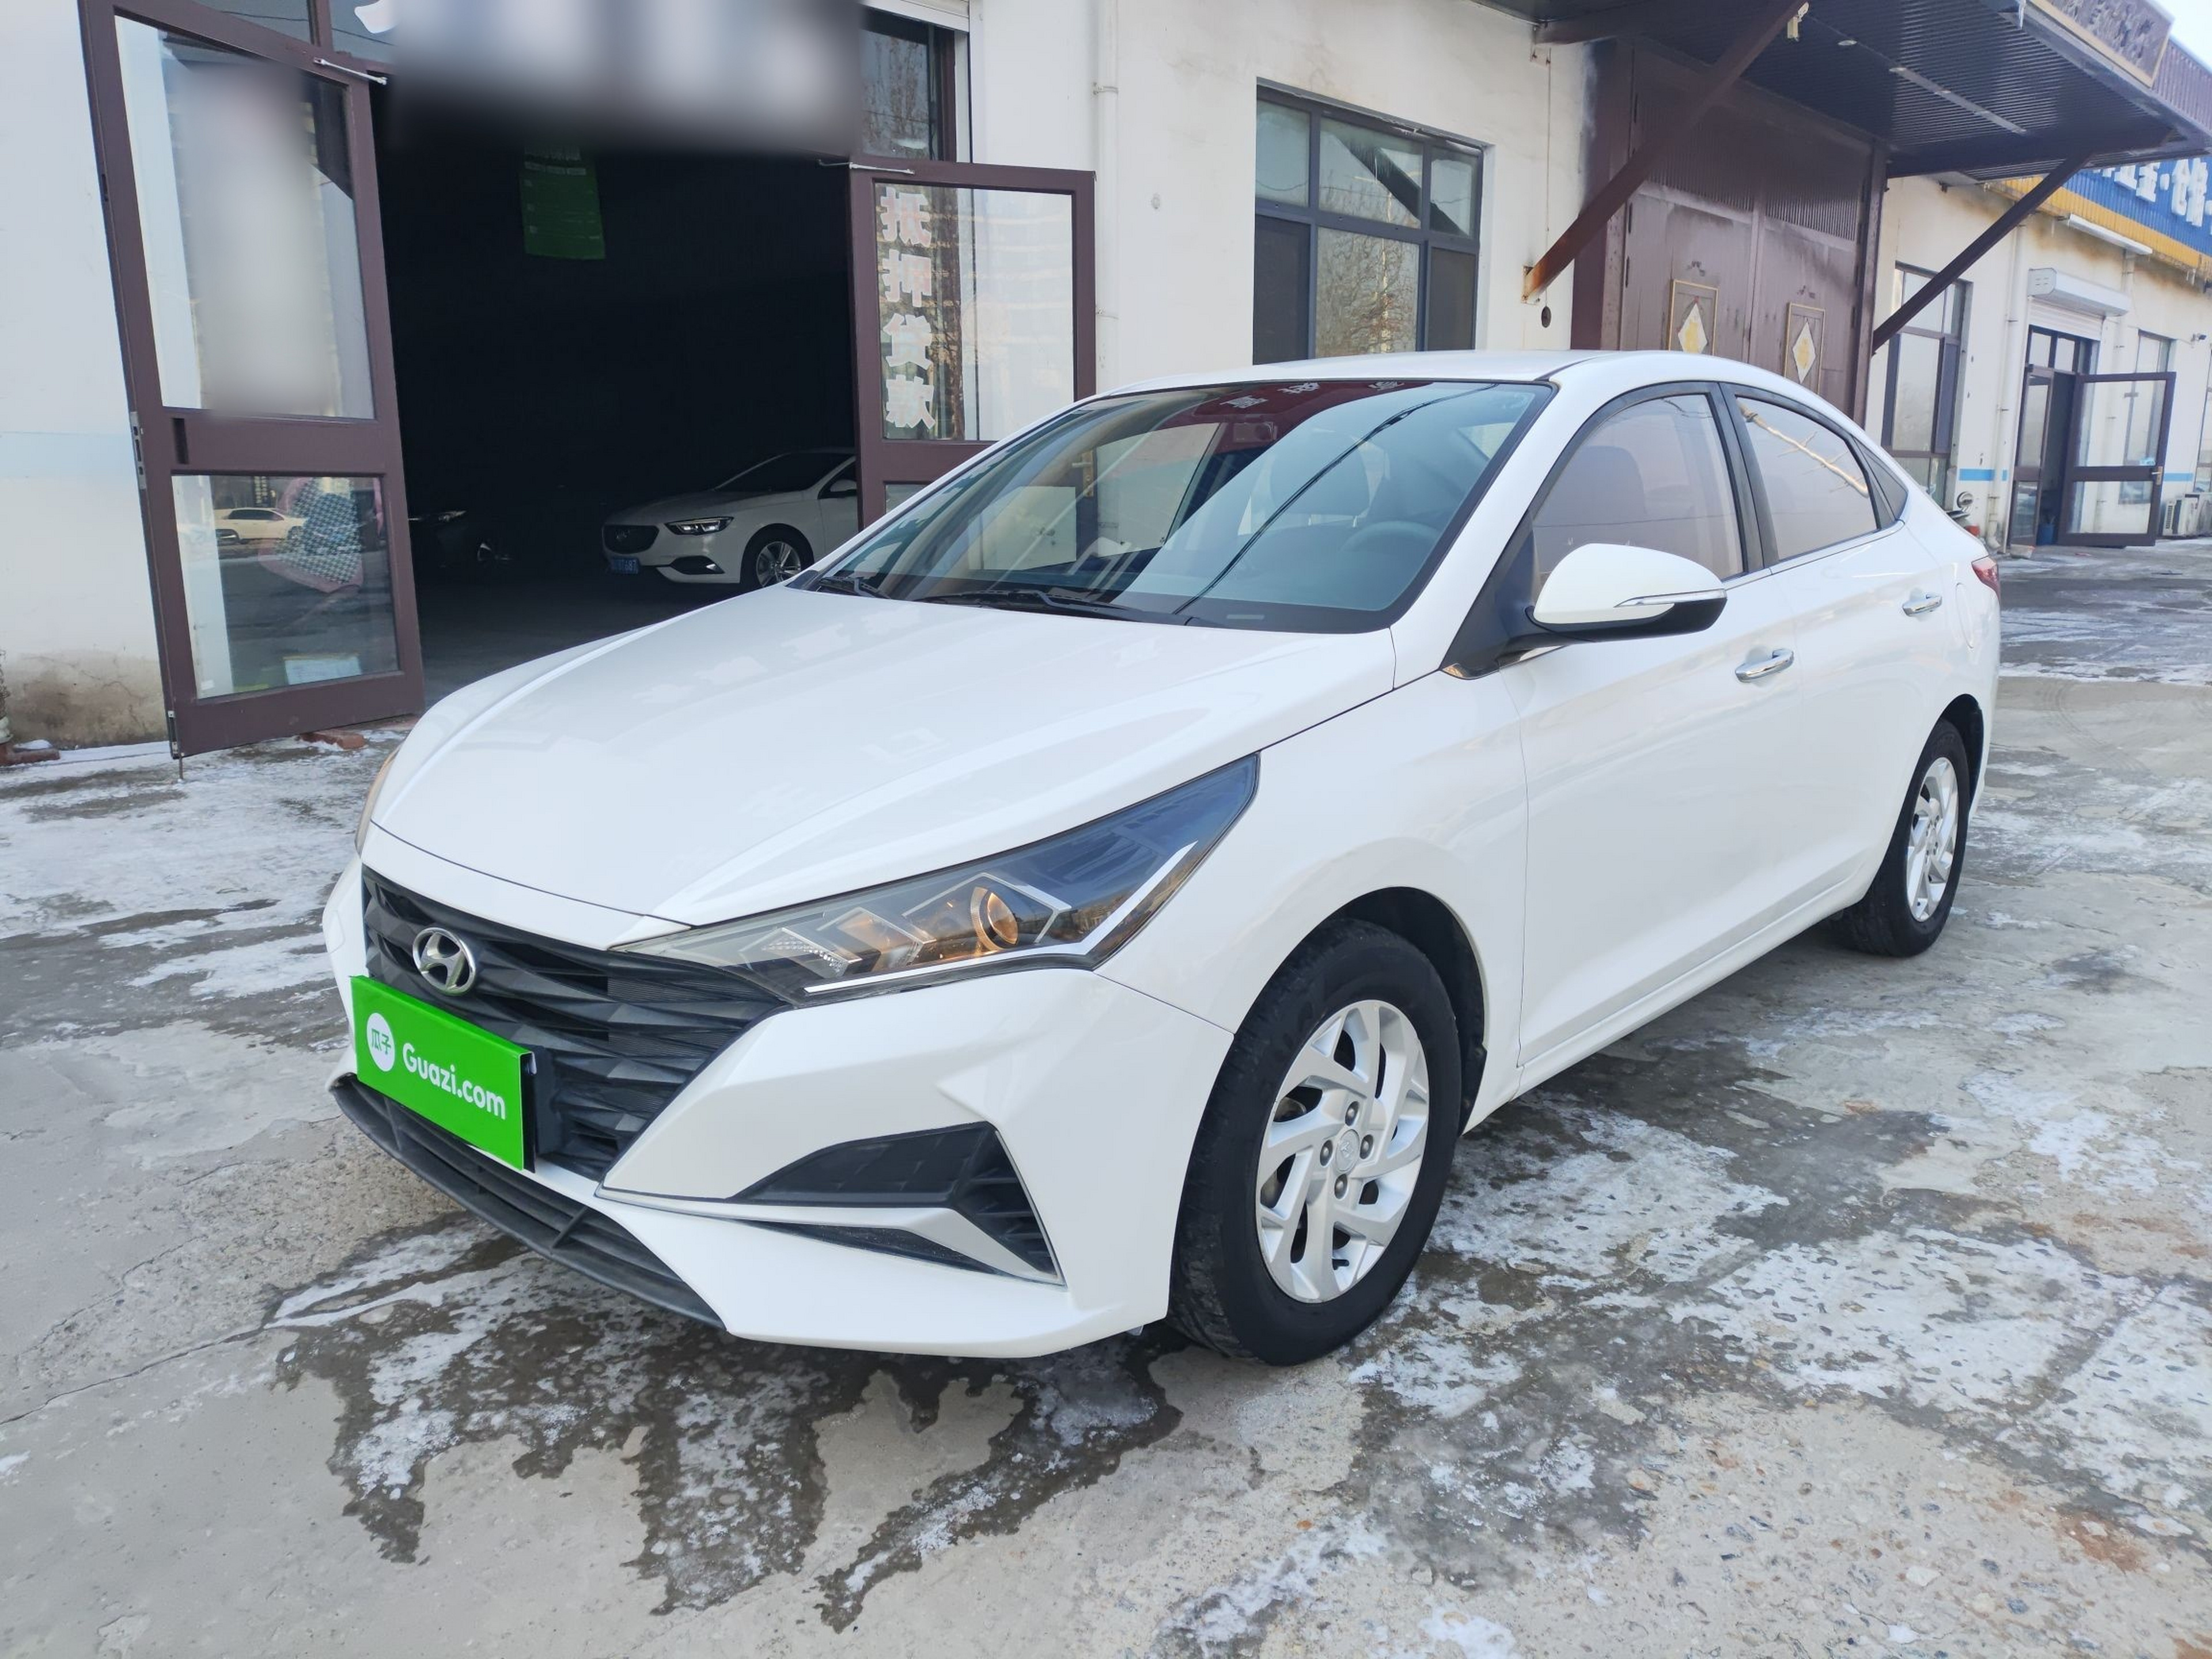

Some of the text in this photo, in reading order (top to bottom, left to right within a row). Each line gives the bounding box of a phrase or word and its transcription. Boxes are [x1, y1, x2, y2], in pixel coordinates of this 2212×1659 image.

[880, 186, 935, 430] 抵押贷款
[371, 1028, 392, 1056] 瓜子
[403, 1042, 506, 1120] Guazi.com
